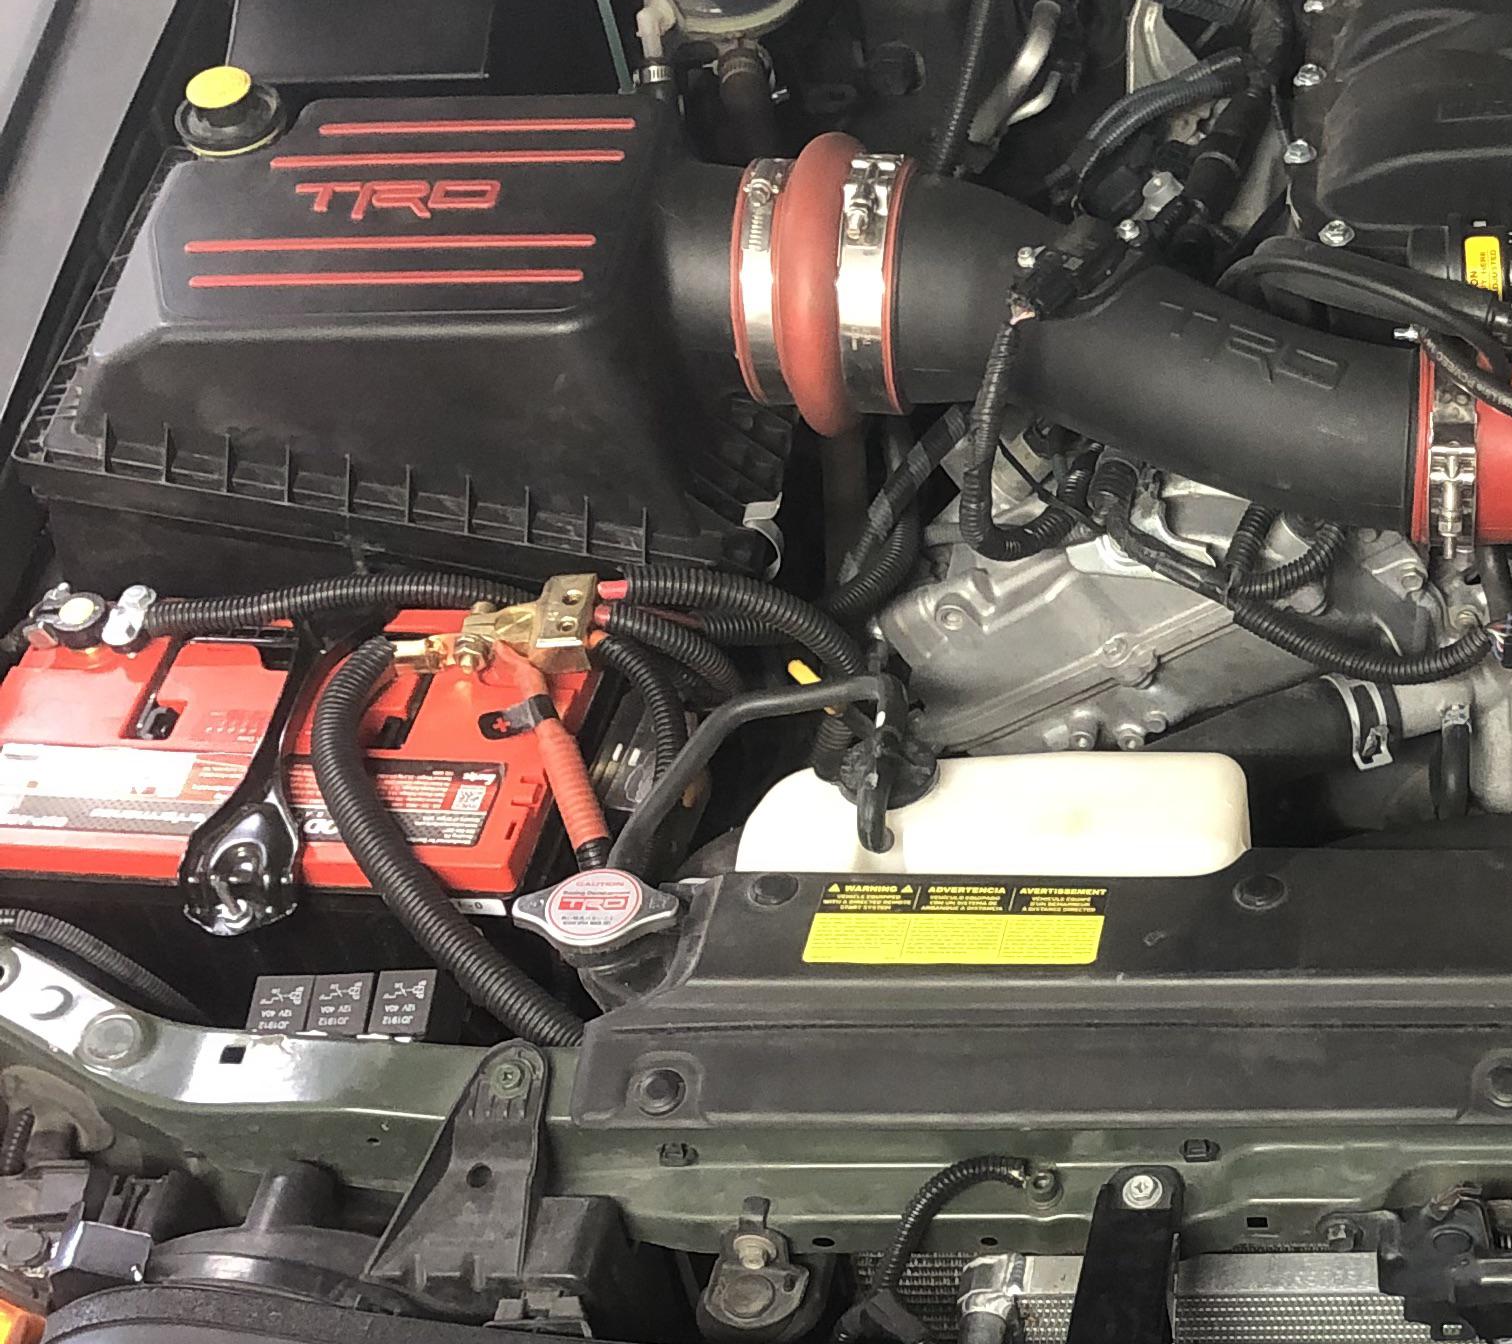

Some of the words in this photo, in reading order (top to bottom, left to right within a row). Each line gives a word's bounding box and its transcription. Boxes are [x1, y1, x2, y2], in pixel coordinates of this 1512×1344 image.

[295, 179, 504, 221] TRD
[1158, 301, 1350, 391] TRD
[844, 884, 898, 893] WARNING
[927, 886, 1006, 894] ADVERTENCIA
[1019, 887, 1107, 896] AVERTISSEMENT
[558, 896, 630, 910] TRD
